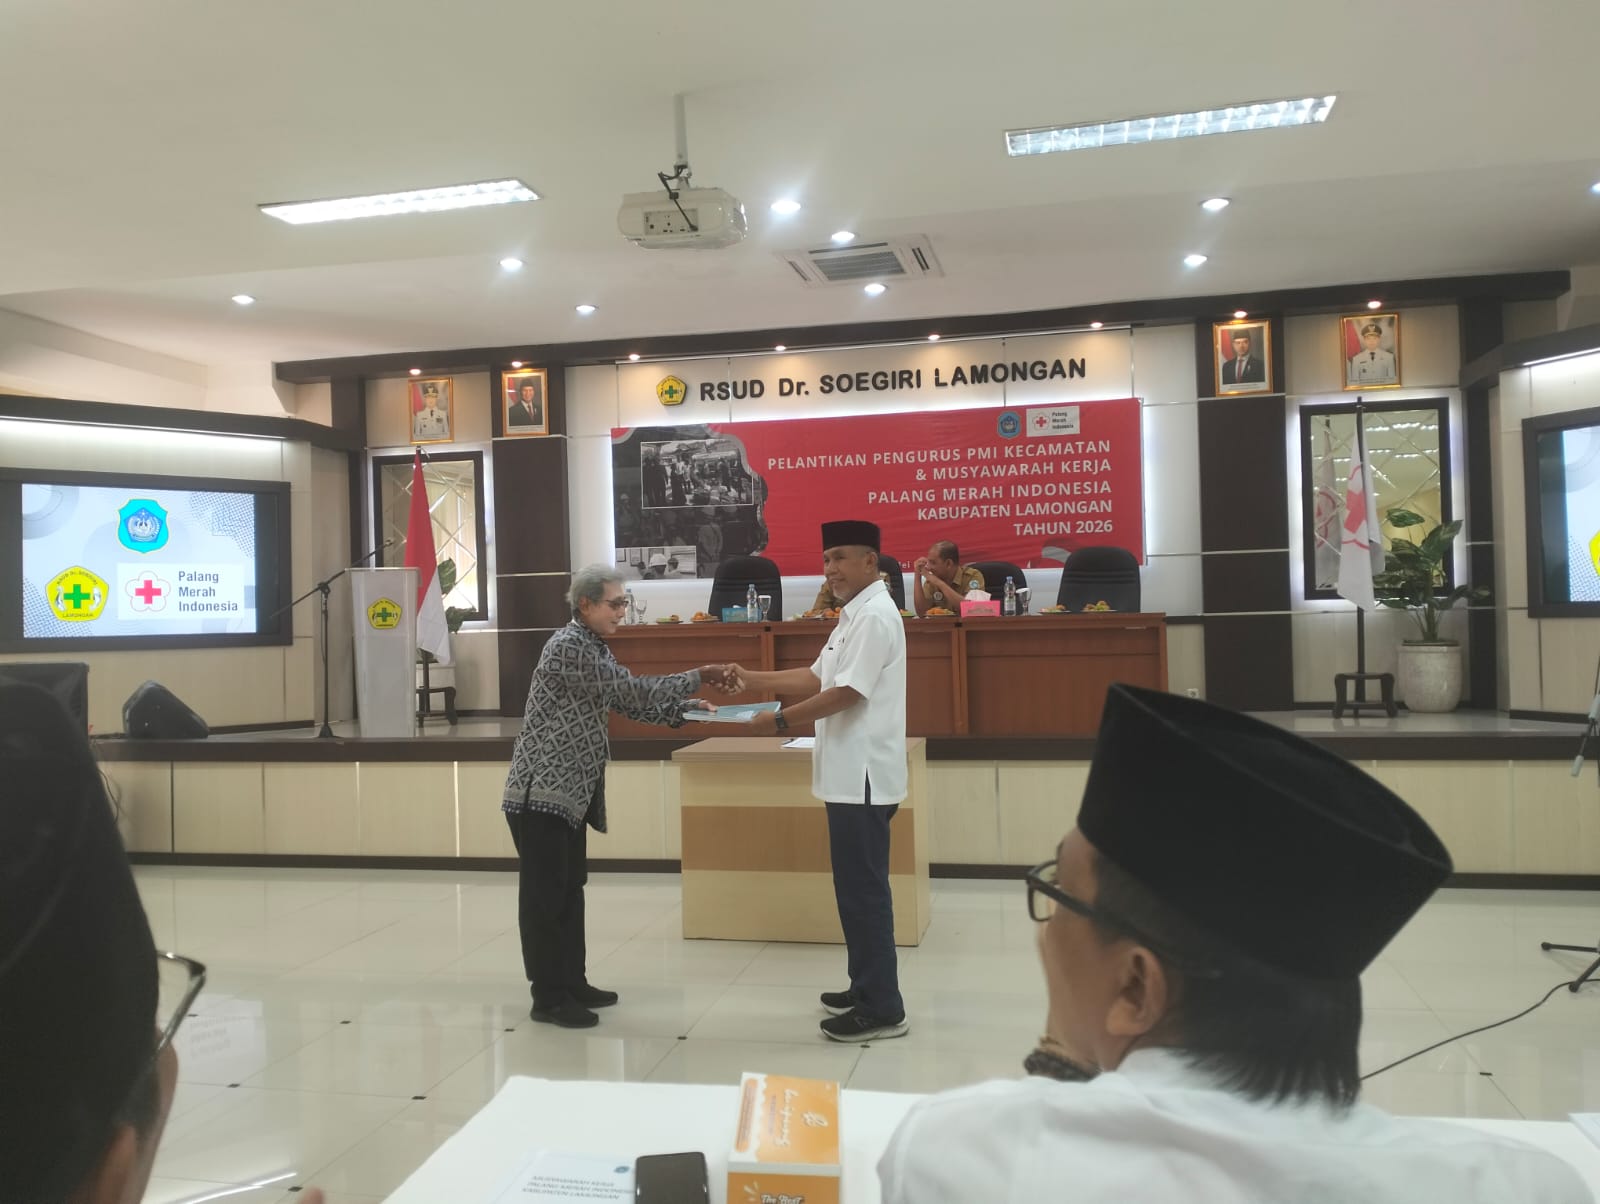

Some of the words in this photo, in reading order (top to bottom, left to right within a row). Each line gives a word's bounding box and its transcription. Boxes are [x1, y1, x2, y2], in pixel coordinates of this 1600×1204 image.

[701, 379, 764, 401] RSUD
[779, 377, 810, 396] Dr.
[820, 368, 921, 394] SOEGIRI
[934, 358, 1086, 387] LAMONGAN
[767, 453, 867, 470] PELANTIKAN
[873, 448, 961, 465] PENGURUS
[967, 446, 998, 460] PMI
[1004, 440, 1111, 458] KECAMATAN
[915, 468, 927, 481] &
[933, 461, 1054, 480] MUSYAWARAH
[1061, 458, 1112, 475] KERJA
[868, 489, 936, 504] PALANG
[943, 486, 1003, 501] MERAH
[1011, 480, 1112, 497] INDONESIA
[917, 504, 1011, 521] KABUPATEN
[1015, 499, 1112, 517] LAMONGAN
[1013, 521, 1071, 536] TAHUN
[1076, 519, 1113, 534] 2026
[178, 570, 219, 584] Palang
[178, 586, 216, 597] Merah
[178, 600, 239, 612] Indonesia
